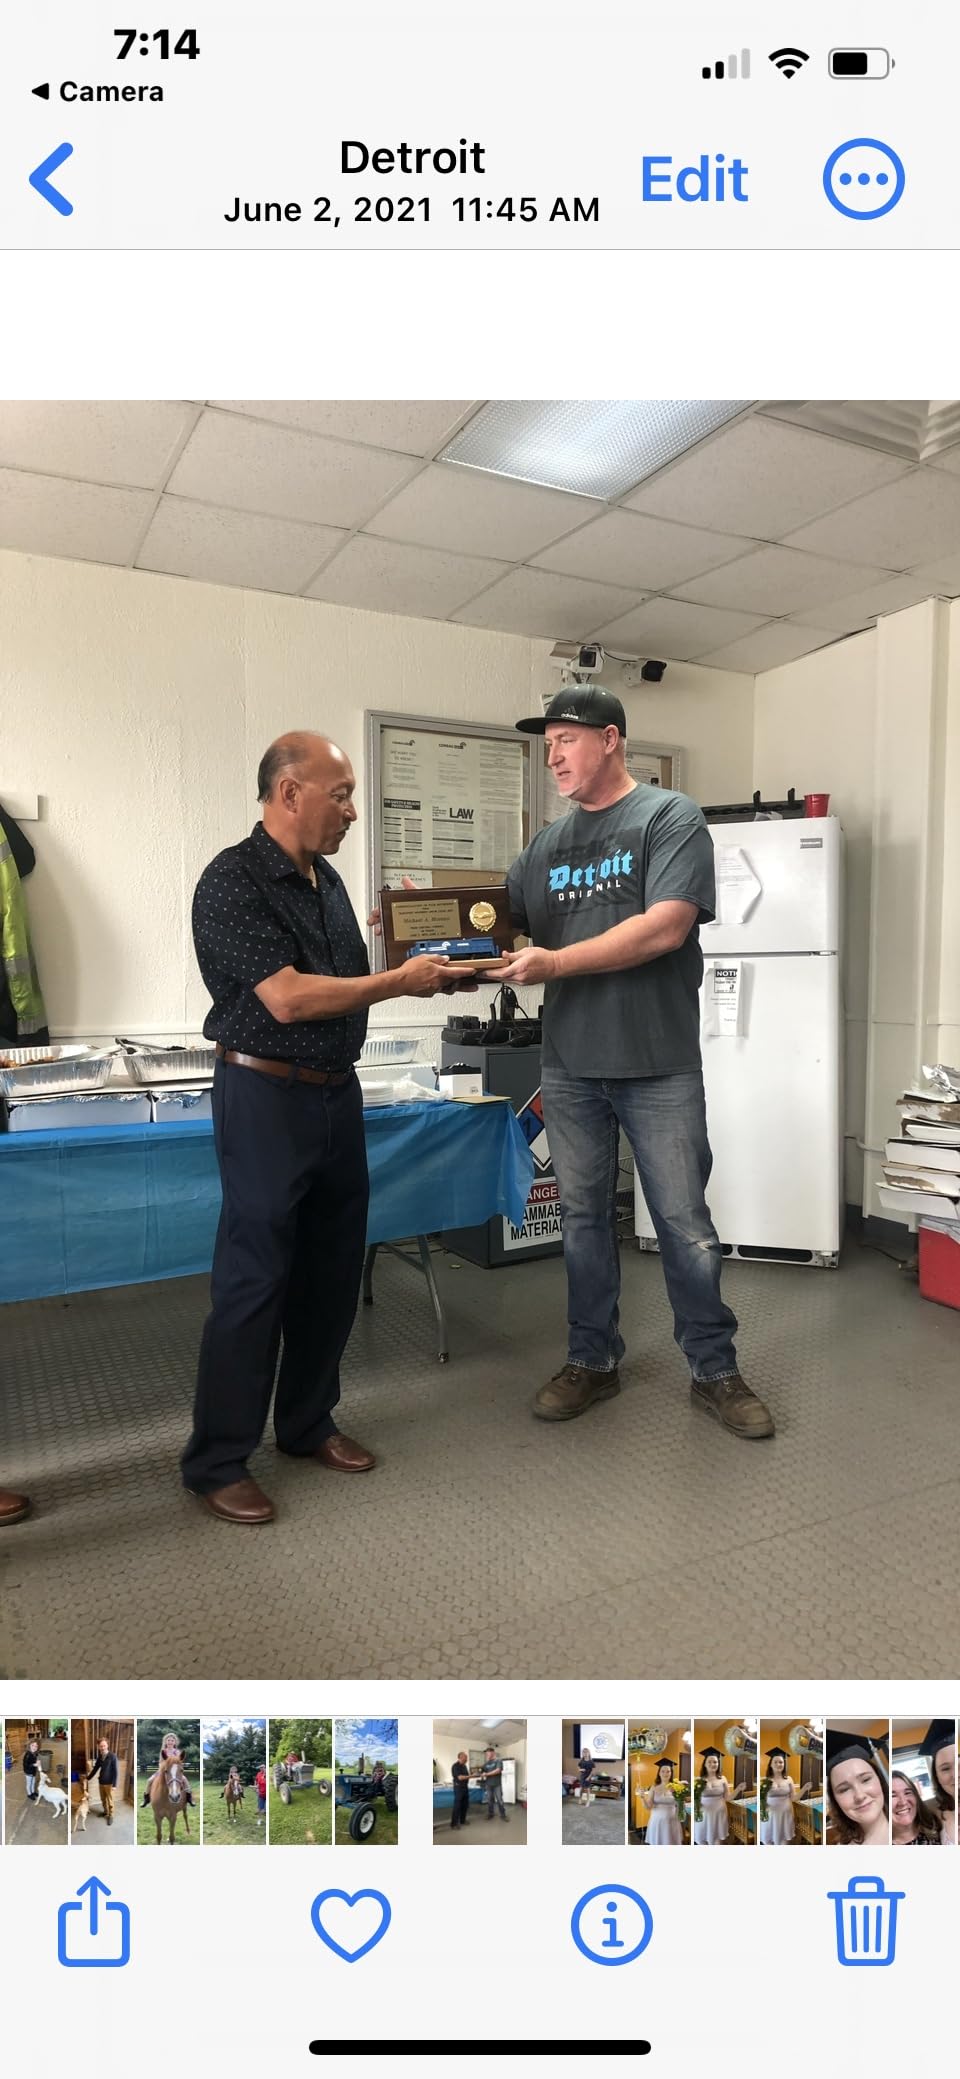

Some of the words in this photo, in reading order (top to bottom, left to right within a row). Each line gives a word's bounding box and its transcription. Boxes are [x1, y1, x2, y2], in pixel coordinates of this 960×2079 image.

[113, 29, 201, 60] 7:14
[59, 81, 164, 103] Camera
[341, 138, 486, 175] Detroit
[642, 154, 749, 203] Edit
[223, 197, 302, 223] June
[313, 197, 341, 228] 2,
[354, 197, 430, 223] 2021
[452, 197, 538, 223] 11:45
[548, 197, 599, 222] AM
[449, 807, 474, 820] LAW
[549, 849, 633, 893] Detoit
[558, 879, 621, 901] ORIGNAL
[528, 1186, 560, 1200] ANGE
[507, 1202, 561, 1225] AMMAB
[511, 1218, 563, 1240] MATERIAL
